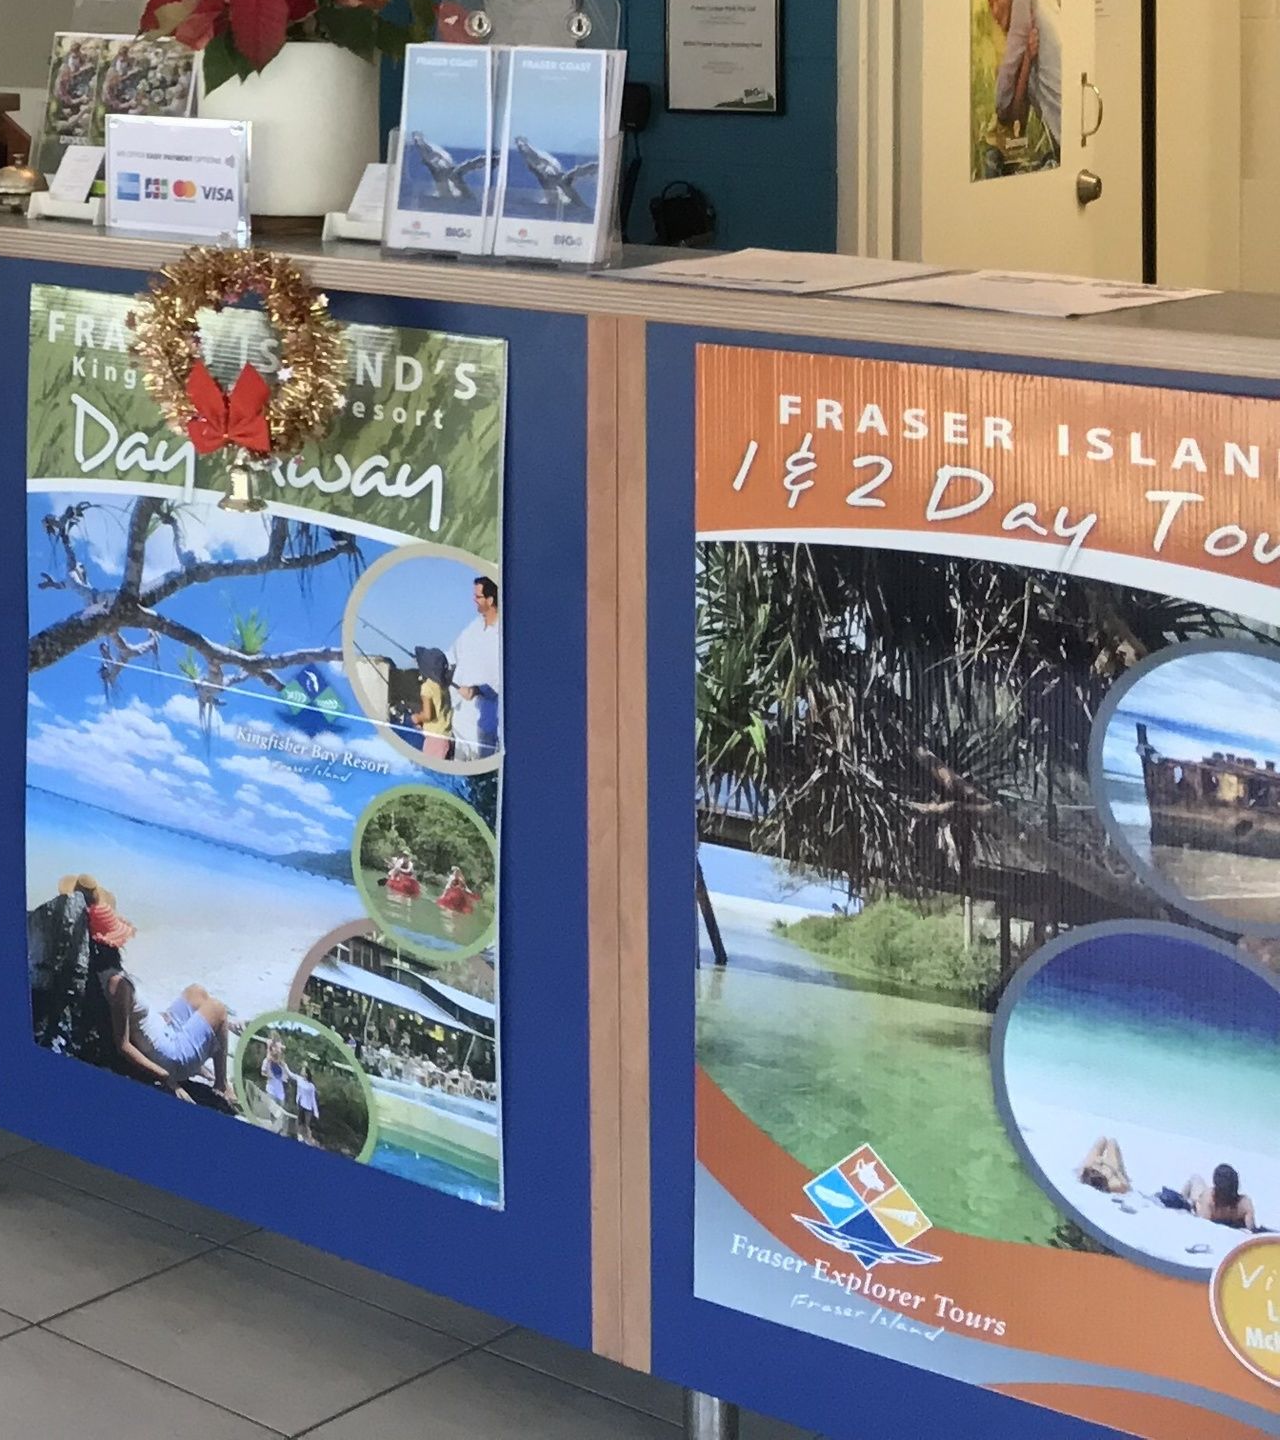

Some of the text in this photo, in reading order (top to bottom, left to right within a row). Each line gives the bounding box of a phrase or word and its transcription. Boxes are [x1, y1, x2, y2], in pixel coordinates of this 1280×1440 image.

[522, 60, 592, 72] FRASER COAST
[146, 152, 162, 160] EASY
[163, 153, 193, 162] PAYMENT
[200, 185, 235, 202] VISA
[239, 331, 478, 401] ISND'S
[351, 400, 444, 430] esort
[778, 393, 1280, 480] FRASER ISLAN
[70, 393, 197, 504] Day
[782, 431, 818, 510] &
[845, 454, 895, 509] 2
[925, 463, 1098, 574] Day
[236, 725, 391, 775] Kingfisher Bay Resort
[312, 764, 353, 783] Island
[730, 1232, 1008, 1338] Fraser Explorer Tours
[790, 1293, 945, 1342] Fraser Island
